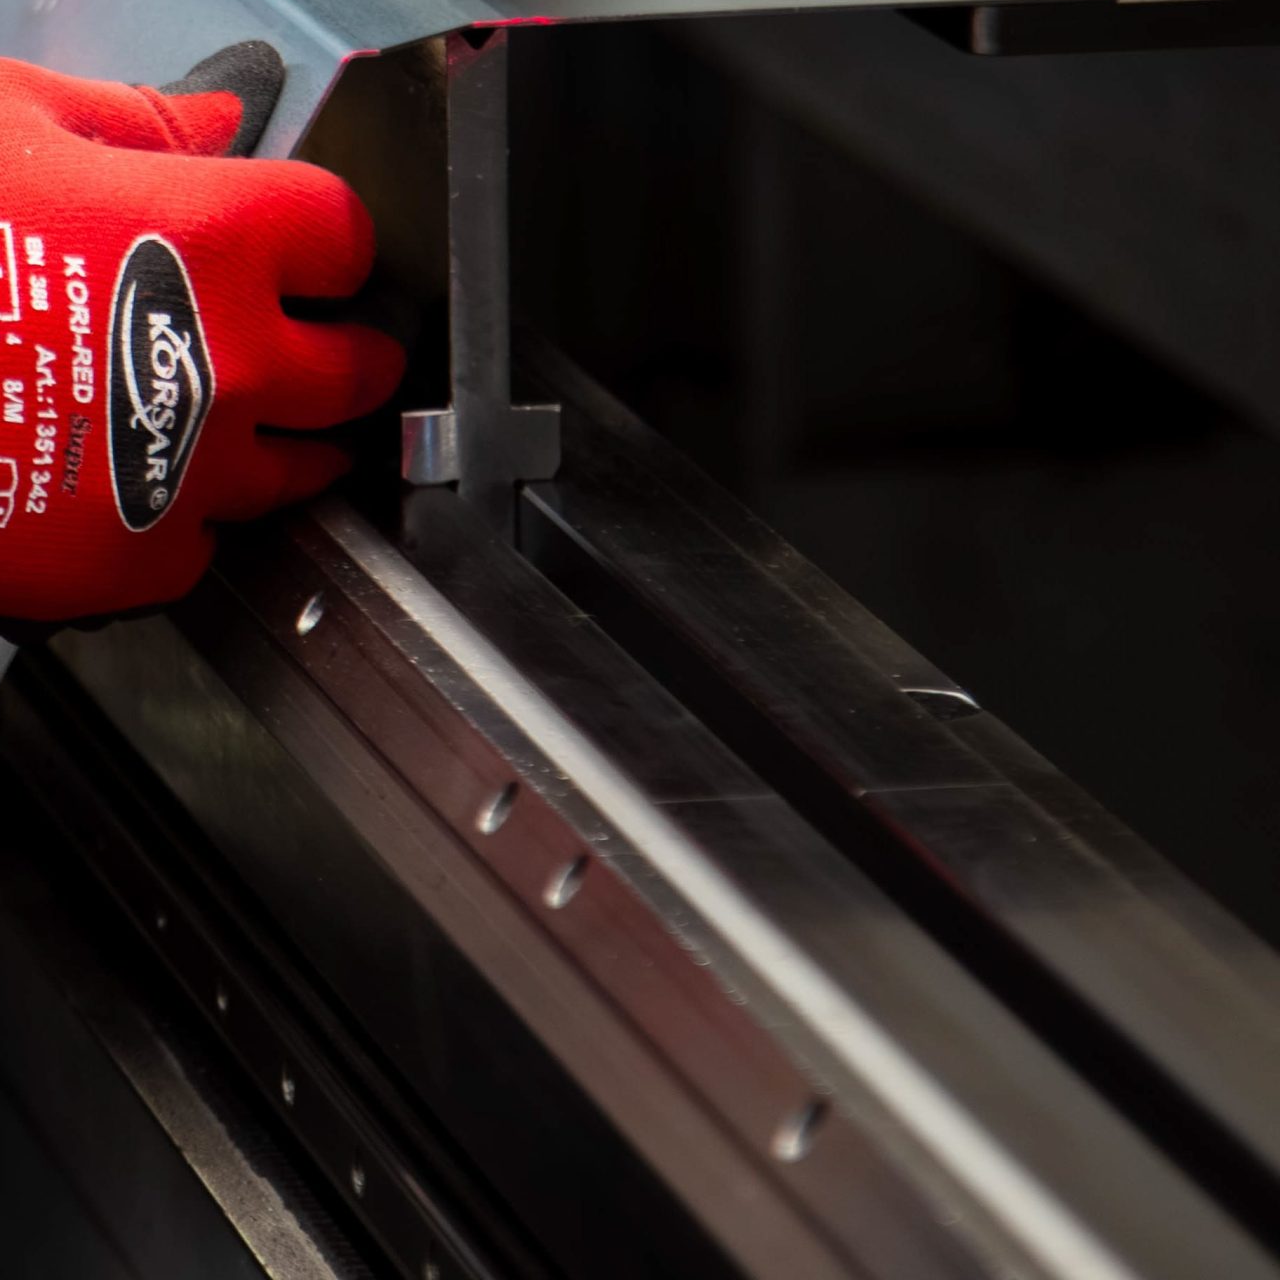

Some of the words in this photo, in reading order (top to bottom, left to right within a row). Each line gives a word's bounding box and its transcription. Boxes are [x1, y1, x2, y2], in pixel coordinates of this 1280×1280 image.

[24, 236, 45, 266] EN
[29, 274, 49, 311] 388
[5, 332, 22, 345] 4
[63, 255, 95, 404] KORI-RED
[2, 379, 24, 424] 8/M
